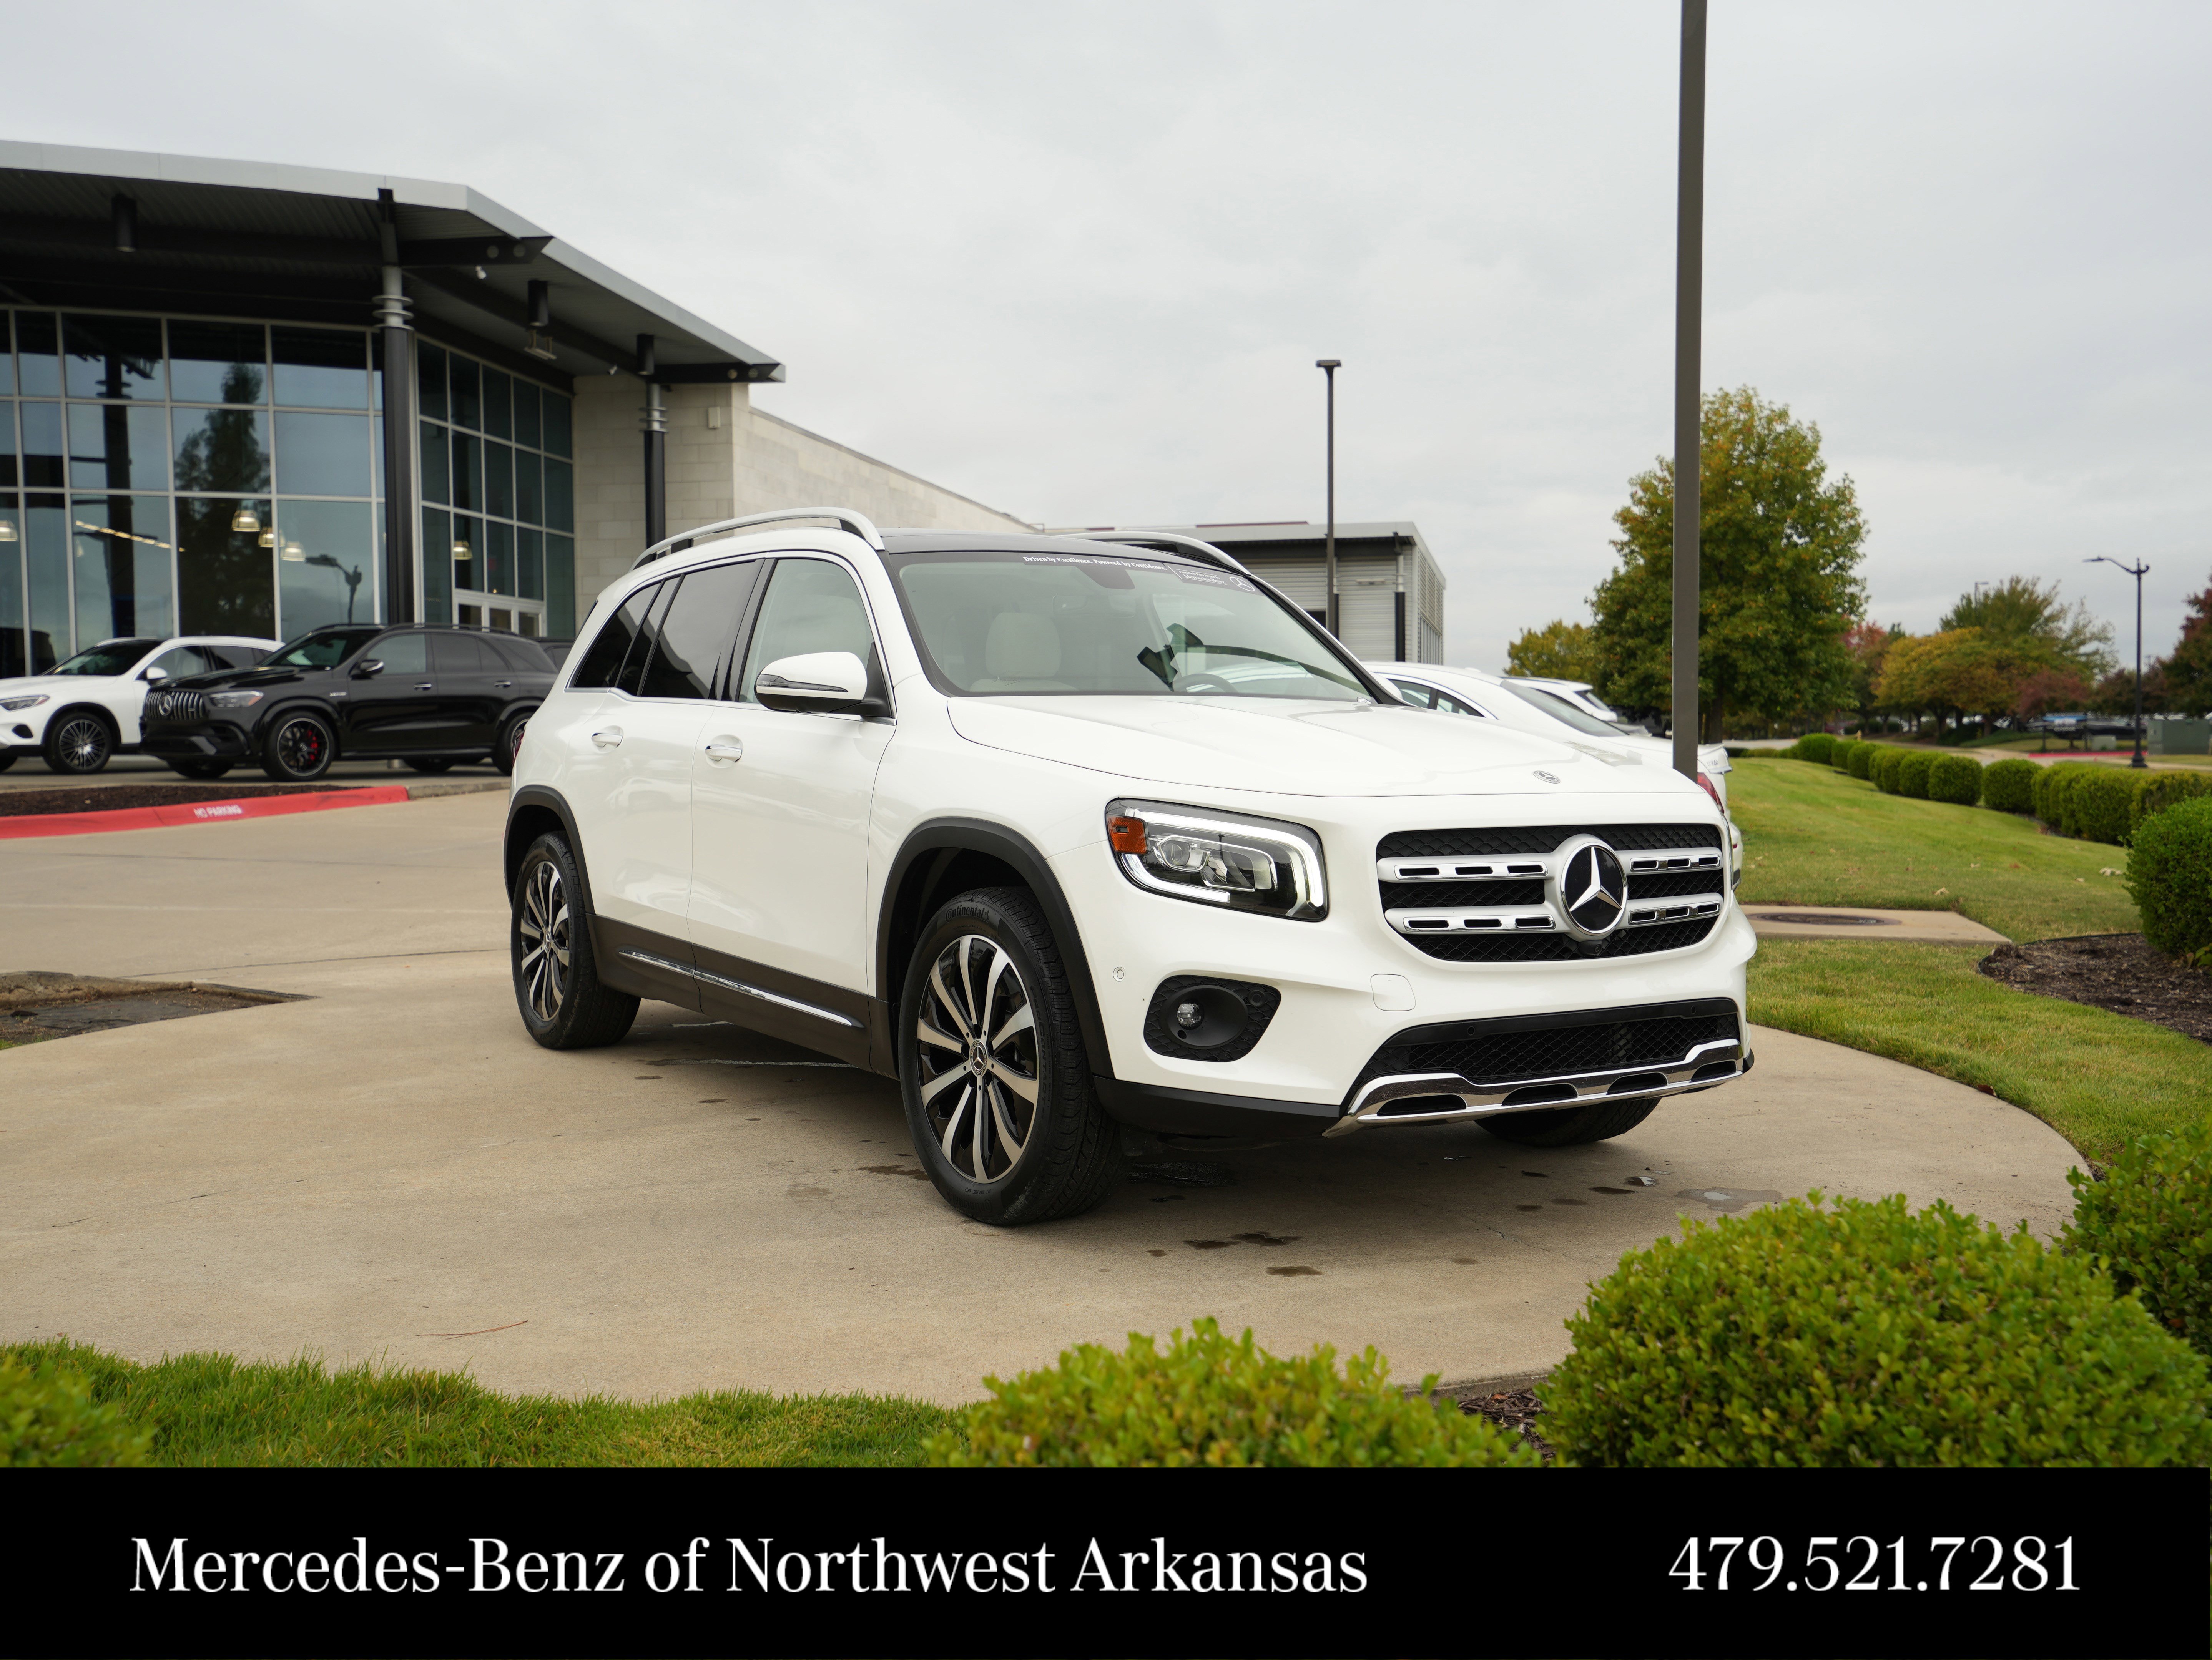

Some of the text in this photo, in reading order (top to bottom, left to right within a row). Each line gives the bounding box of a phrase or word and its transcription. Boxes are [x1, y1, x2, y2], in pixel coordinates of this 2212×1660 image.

[1183, 574, 1226, 584] Mercedes-Benz
[193, 805, 242, 818] NO PARKING
[946, 905, 985, 923] Continental
